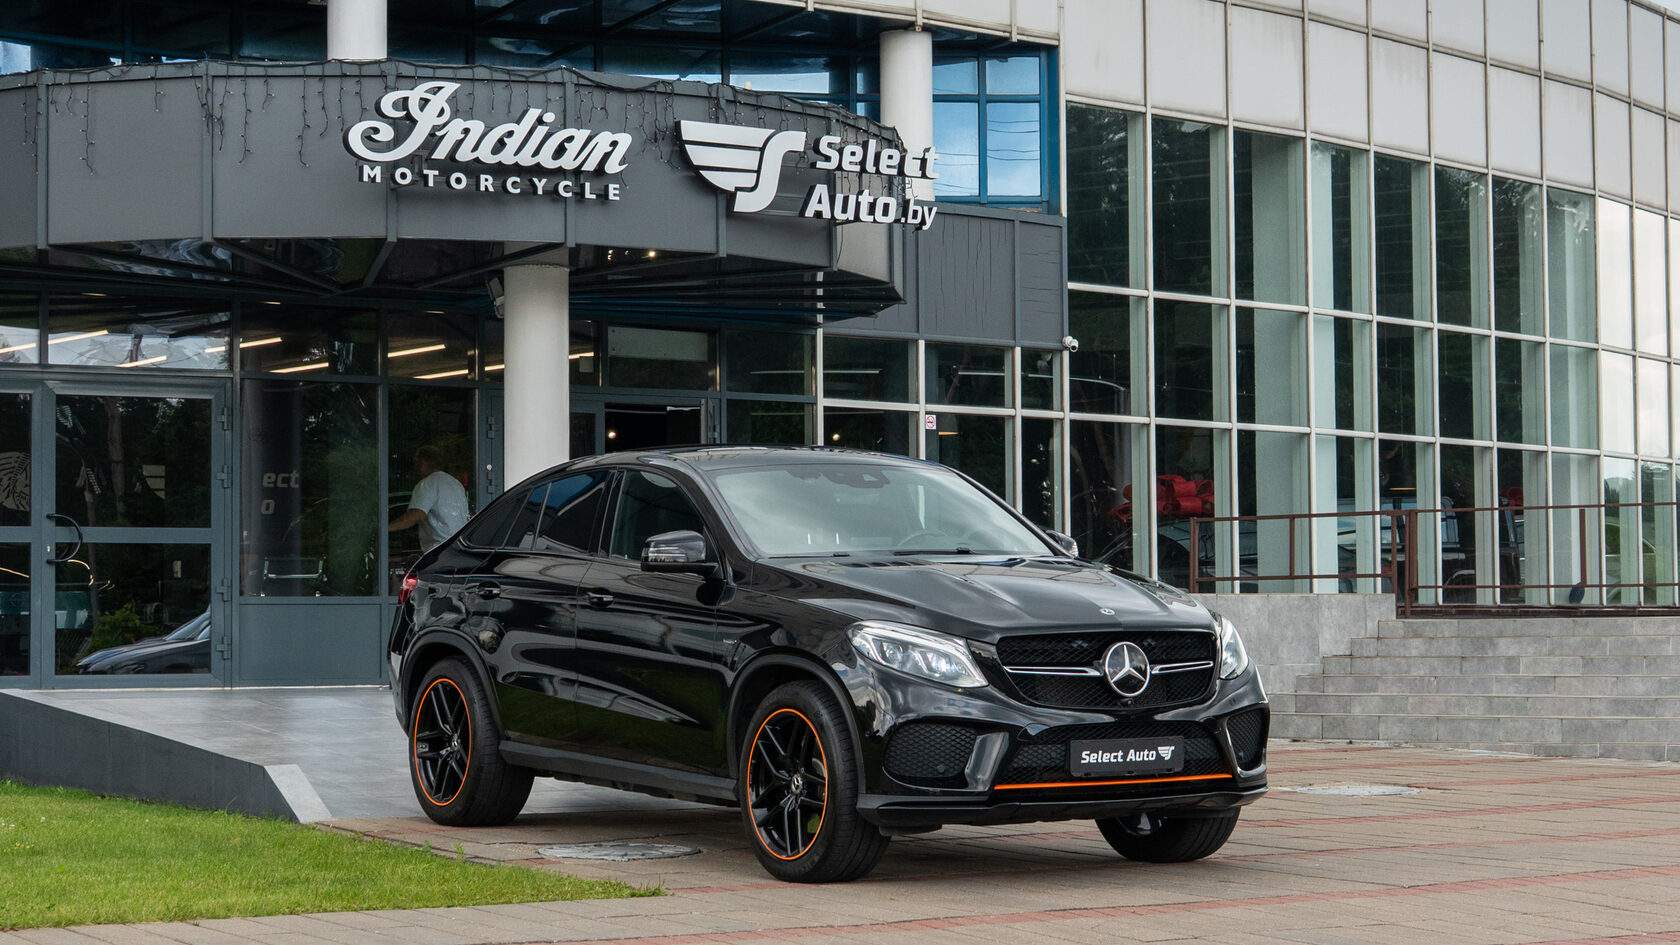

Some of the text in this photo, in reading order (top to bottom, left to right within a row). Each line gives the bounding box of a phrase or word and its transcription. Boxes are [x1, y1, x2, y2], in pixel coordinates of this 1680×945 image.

[347, 81, 633, 174] Indian
[814, 135, 940, 179] Select
[361, 164, 621, 201] MOTORCYCLE
[1080, 748, 1157, 764] Select Auto
